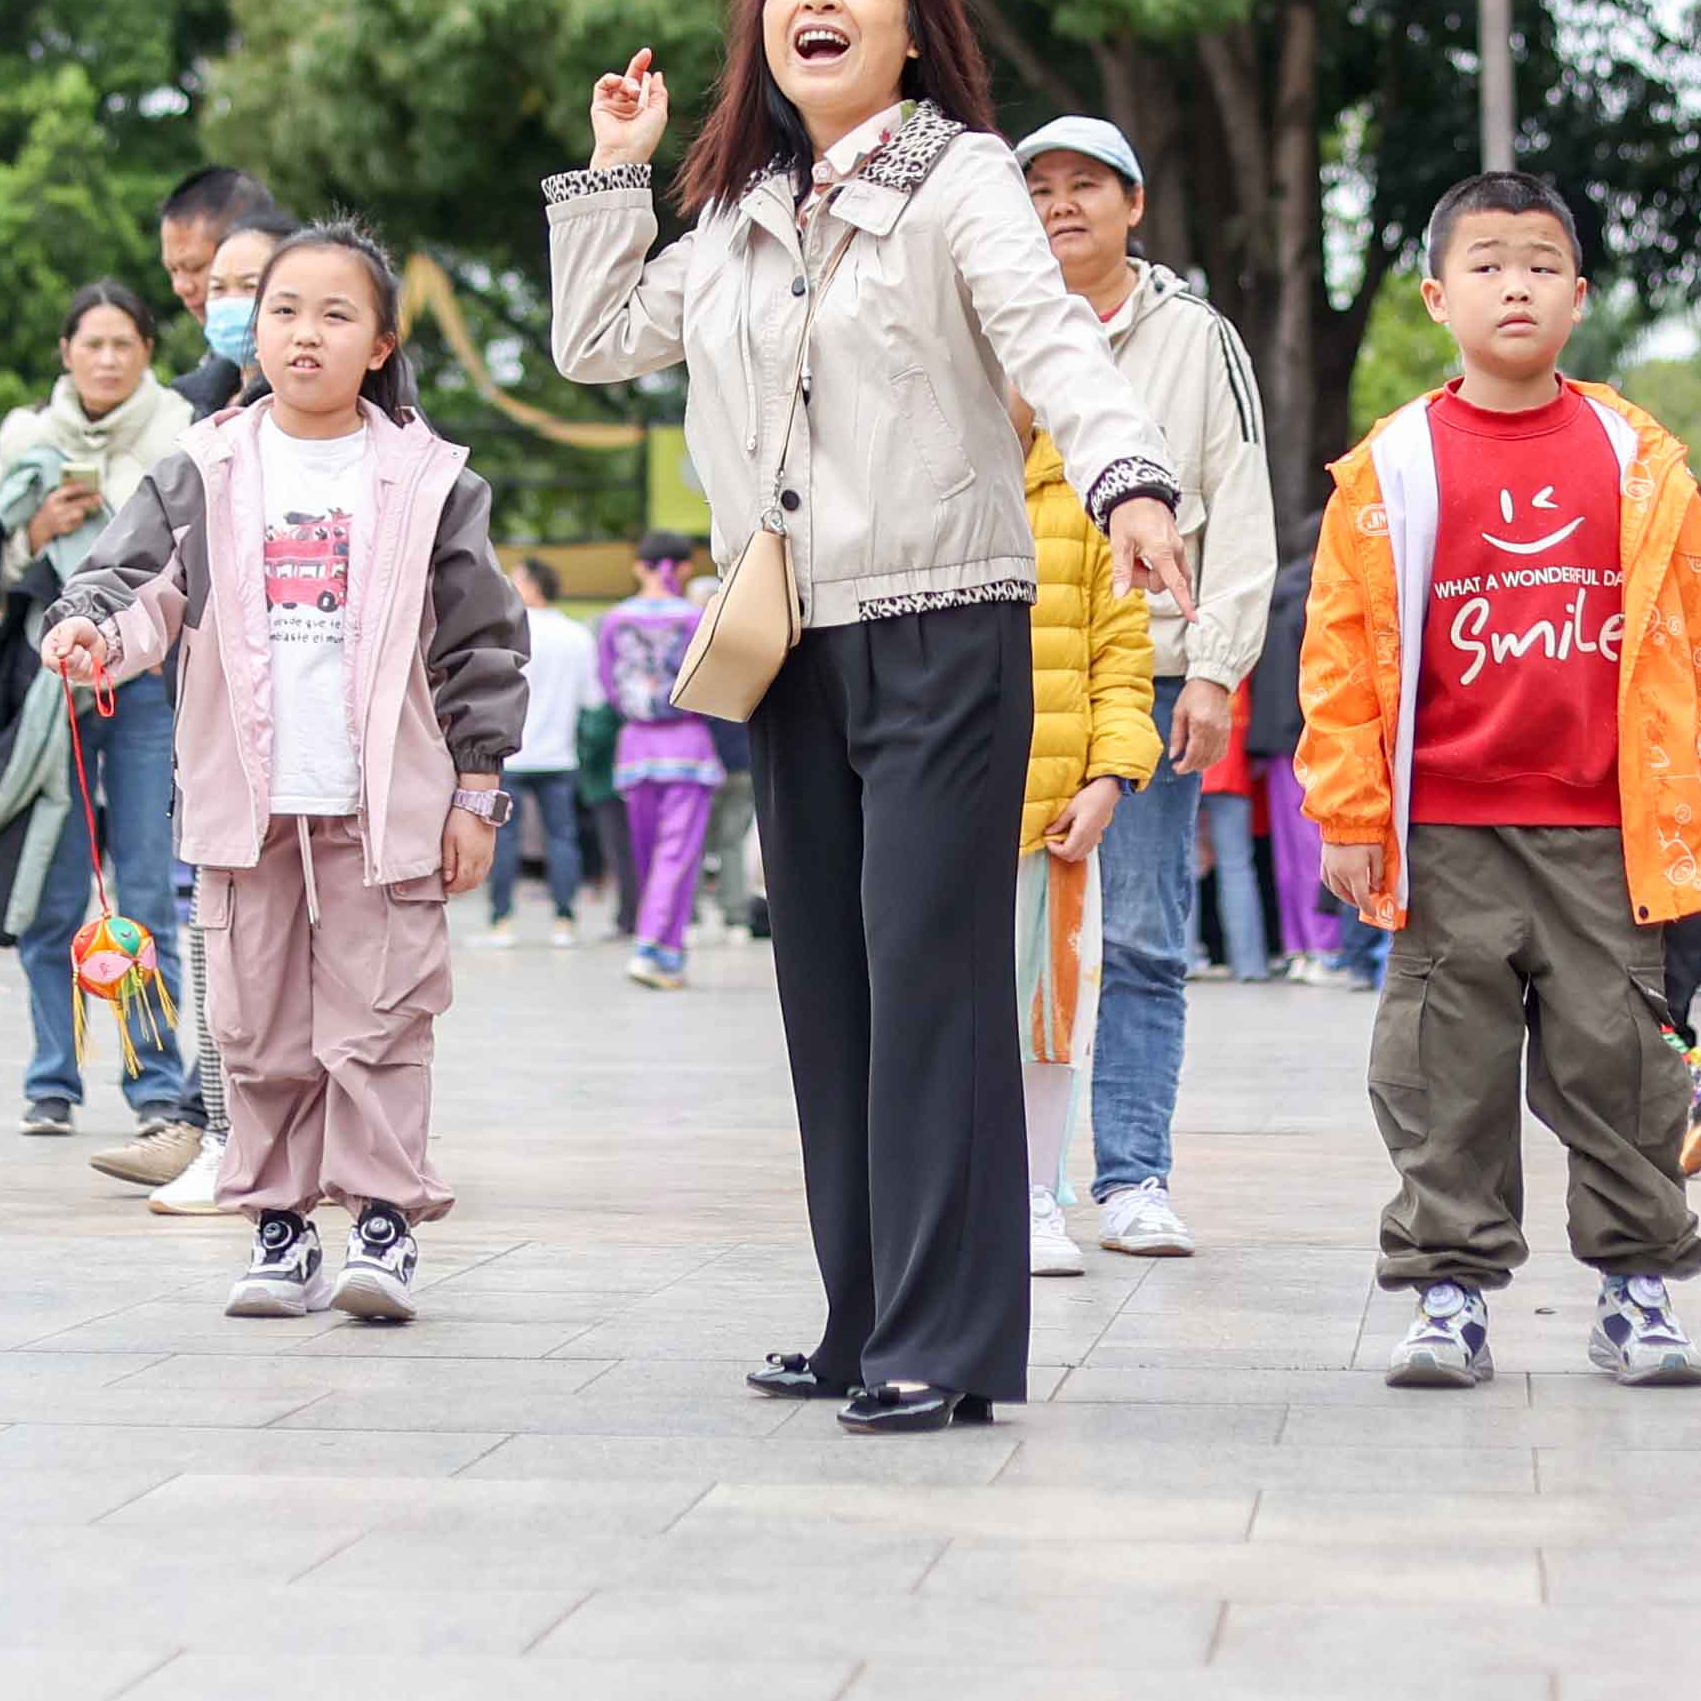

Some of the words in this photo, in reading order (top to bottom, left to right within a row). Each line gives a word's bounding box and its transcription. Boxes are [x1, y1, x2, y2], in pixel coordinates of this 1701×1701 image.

[1434, 576, 1481, 599] WHAT
[1485, 574, 1499, 591] A
[1501, 566, 1600, 588] WONDERFUL
